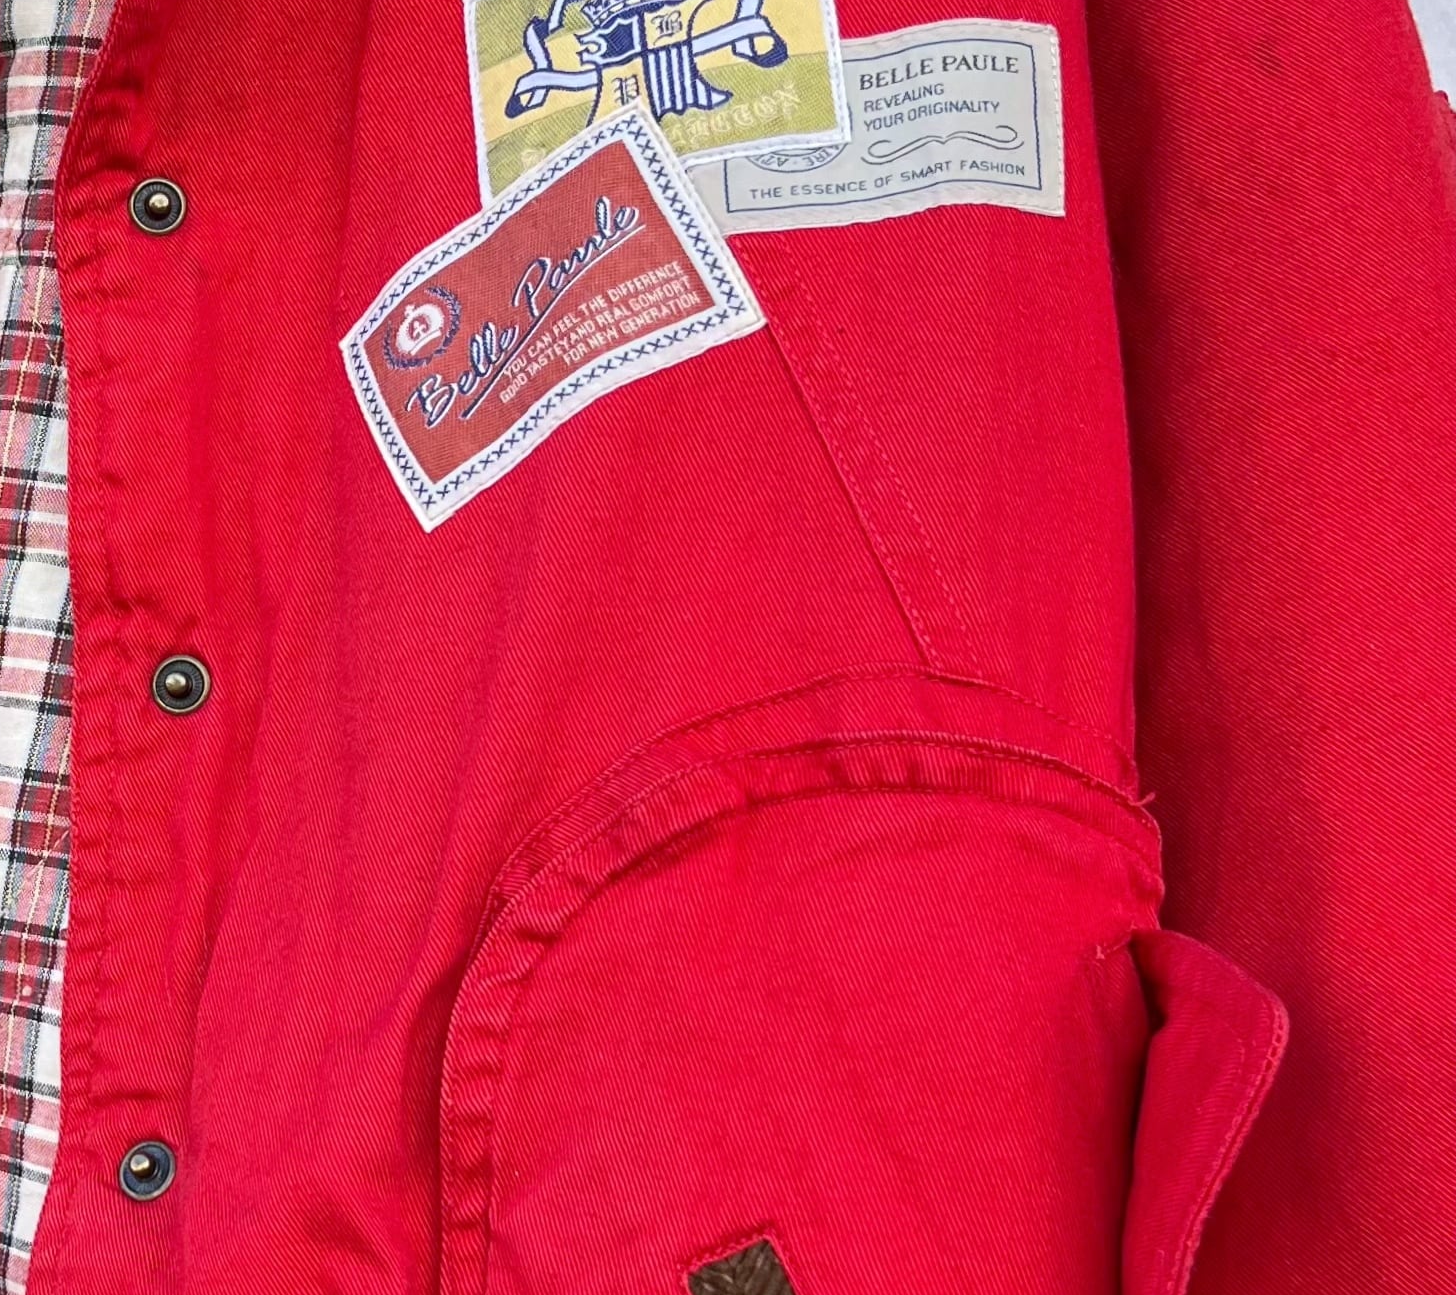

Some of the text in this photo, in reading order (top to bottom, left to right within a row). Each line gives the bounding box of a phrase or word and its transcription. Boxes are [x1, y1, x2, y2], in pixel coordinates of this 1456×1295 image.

[859, 54, 1020, 91] BELLE PAULE
[863, 83, 945, 113] REVEALING
[863, 99, 1001, 133] YOUR ORIGINALITY
[749, 159, 1026, 200] THE ESSENCE OF SMART FASHION
[405, 195, 640, 429] Belle Paule
[502, 260, 686, 380] YOU CAN FEEL THE DIFFERENCE
[562, 290, 701, 367] FOR NEW GENERATION
[498, 374, 528, 404] GOOD
[596, 303, 631, 329] REAL
